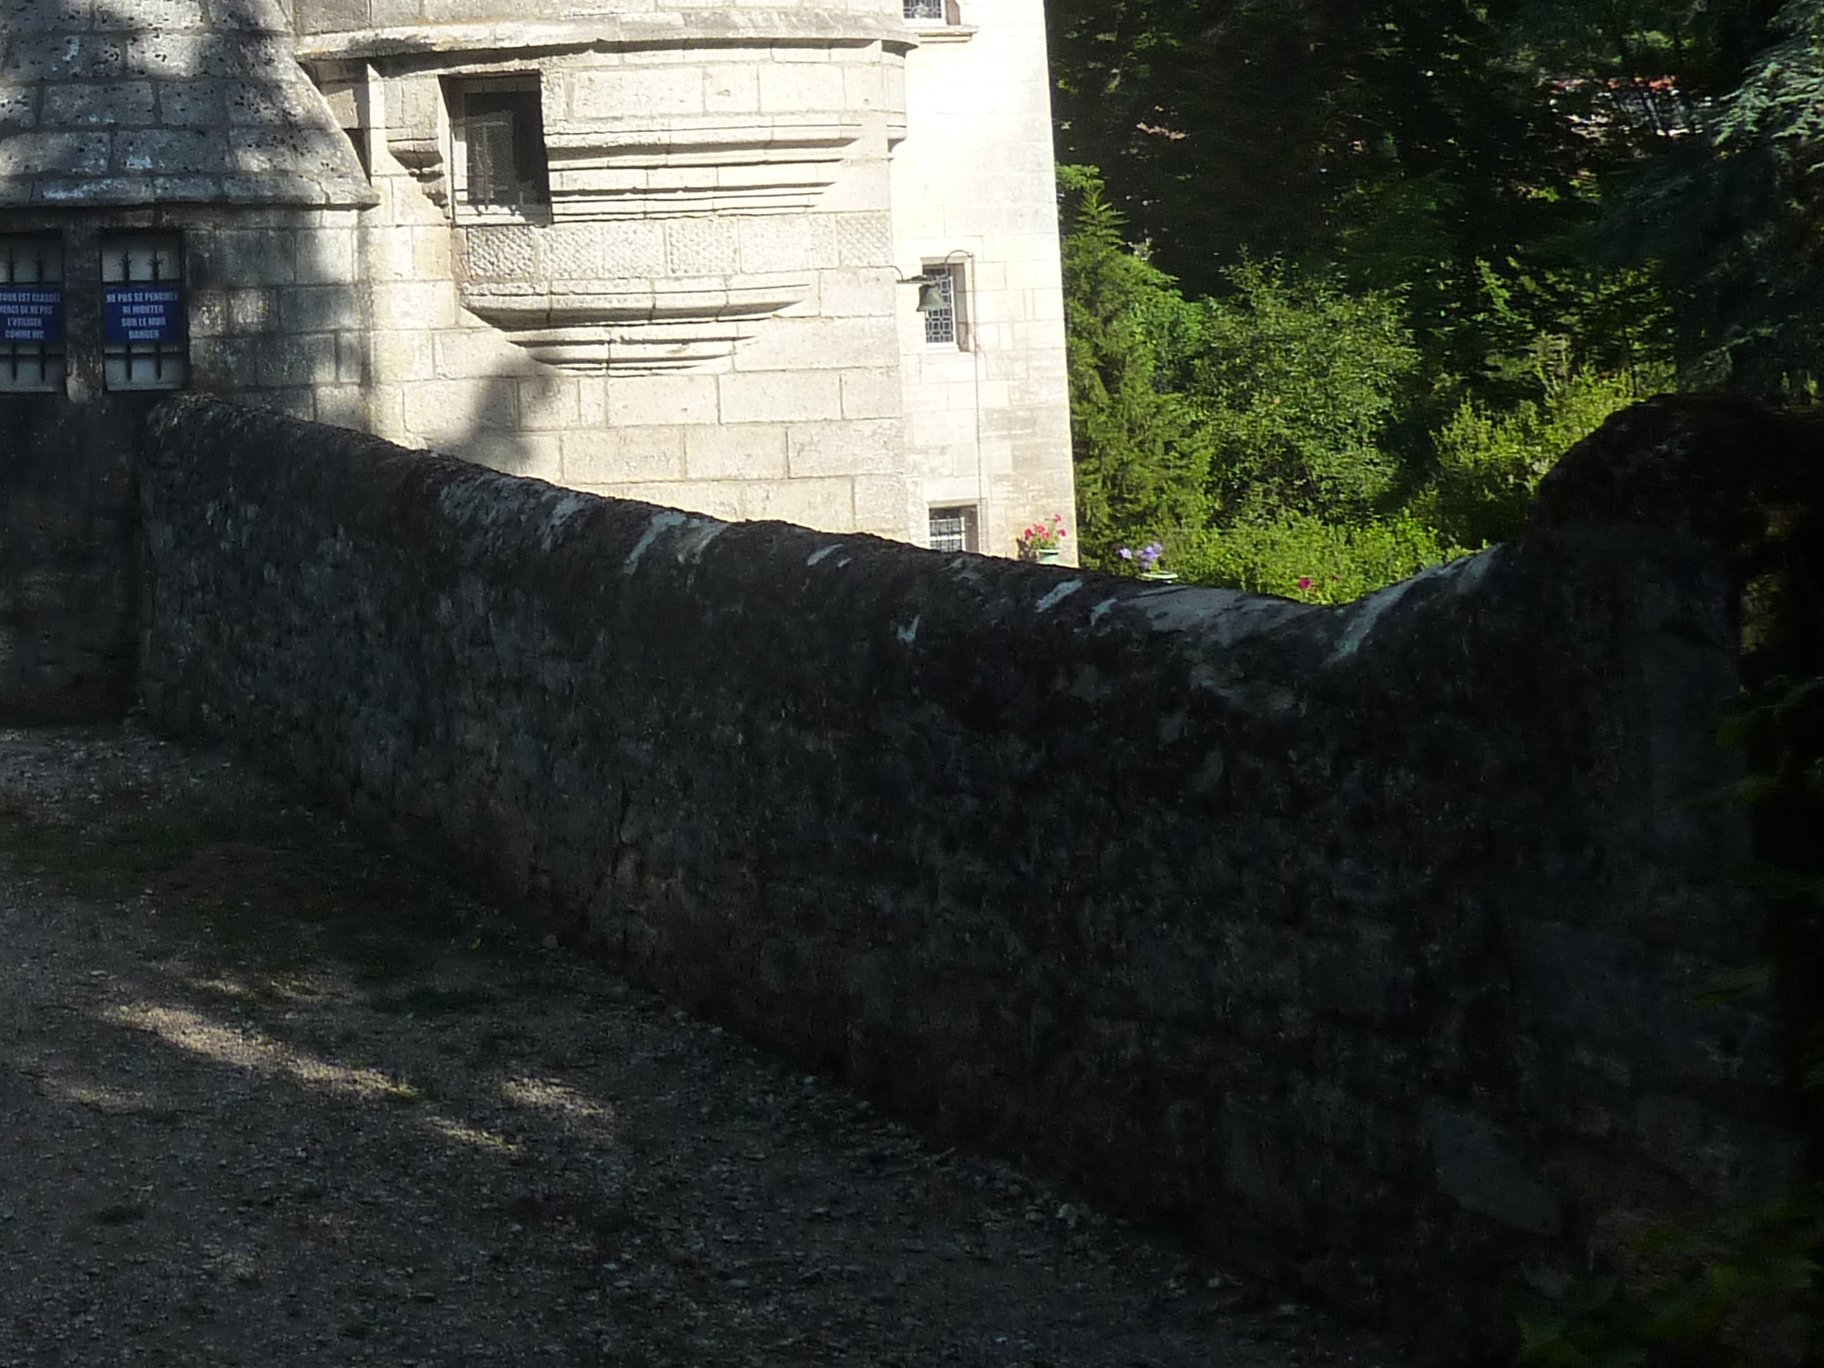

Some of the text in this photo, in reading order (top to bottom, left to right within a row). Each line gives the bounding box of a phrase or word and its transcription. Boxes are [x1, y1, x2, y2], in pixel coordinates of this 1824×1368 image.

[18, 293, 30, 302] EST
[106, 293, 116, 303] NE
[117, 293, 132, 302] PAS
[133, 292, 143, 302] SE
[39, 305, 53, 315] PAS
[132, 304, 164, 314] MONTER
[121, 317, 137, 327] SUR
[139, 317, 147, 327] LE
[128, 329, 160, 339] DANGER
